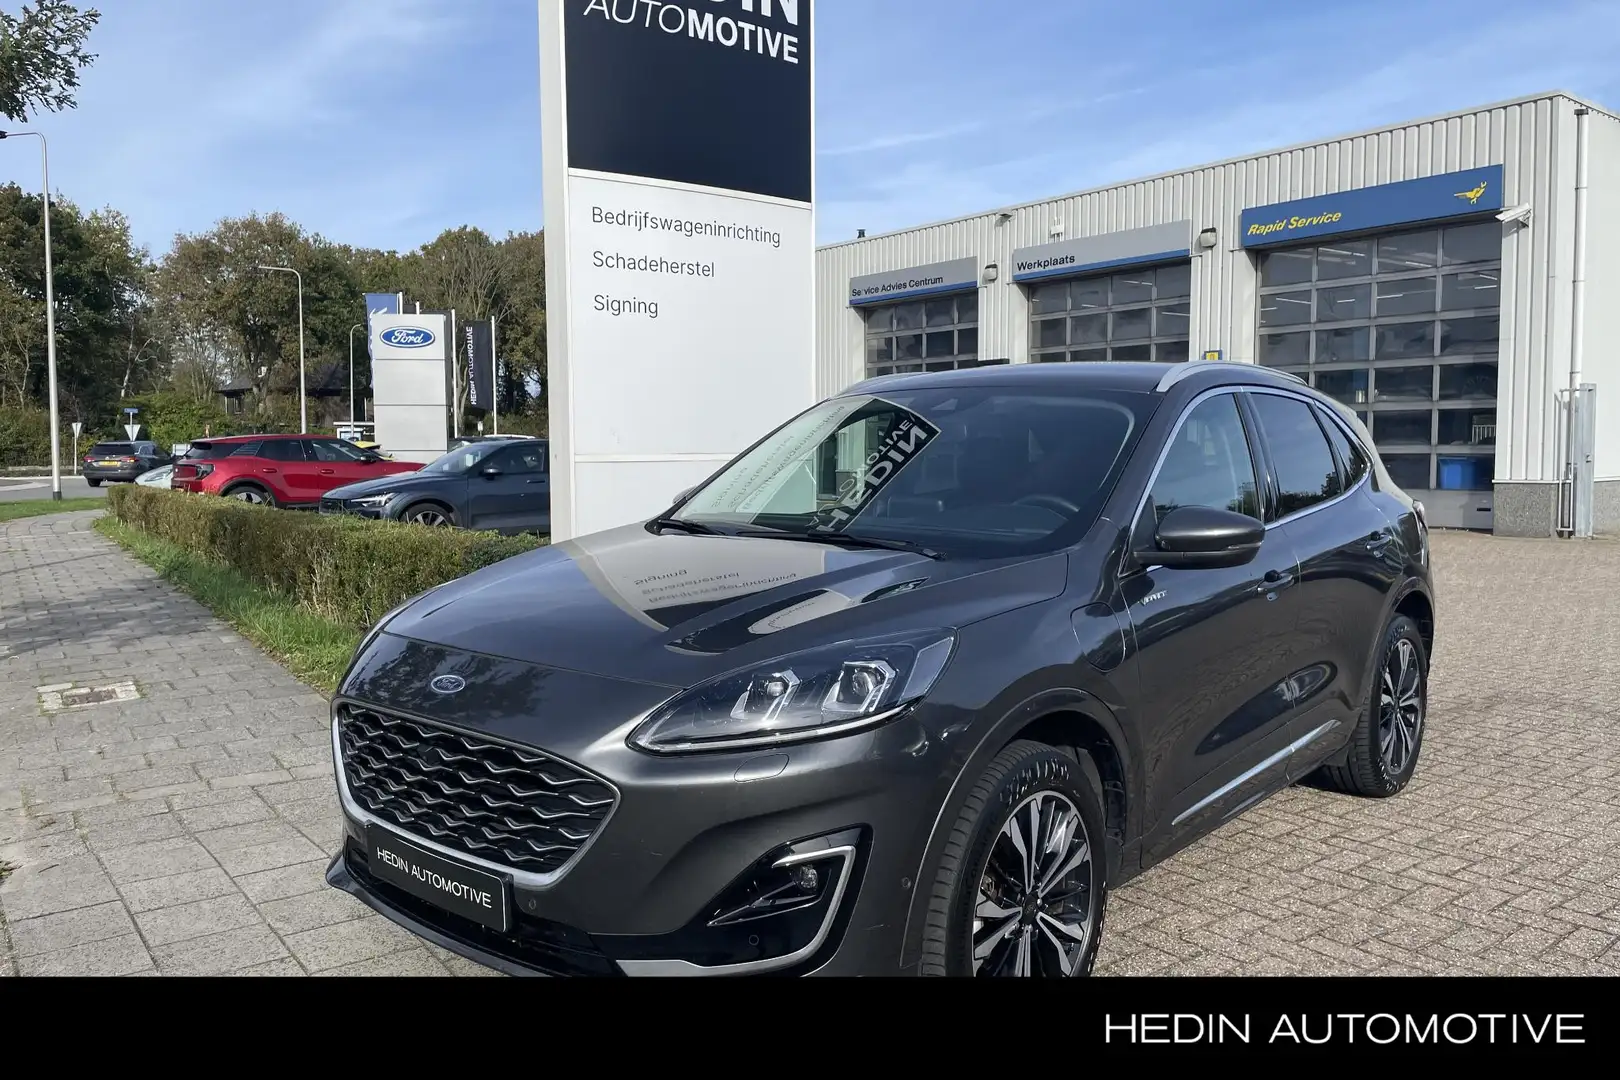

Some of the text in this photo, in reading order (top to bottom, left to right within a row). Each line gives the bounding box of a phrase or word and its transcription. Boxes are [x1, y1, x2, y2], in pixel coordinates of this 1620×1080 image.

[583, 0, 798, 64] AUTOMOTIVE
[592, 206, 781, 248] Bedrijfswageninrichting
[1247, 212, 1342, 235] Rapid Service
[592, 250, 715, 278] Schadeherstel
[1017, 254, 1075, 271] Werkplaats
[852, 276, 943, 297] Sevice Advies Centrum
[593, 294, 659, 318] Signing
[391, 329, 424, 343] Ford
[376, 846, 492, 909] HEDIN AUTOMOTIVE
